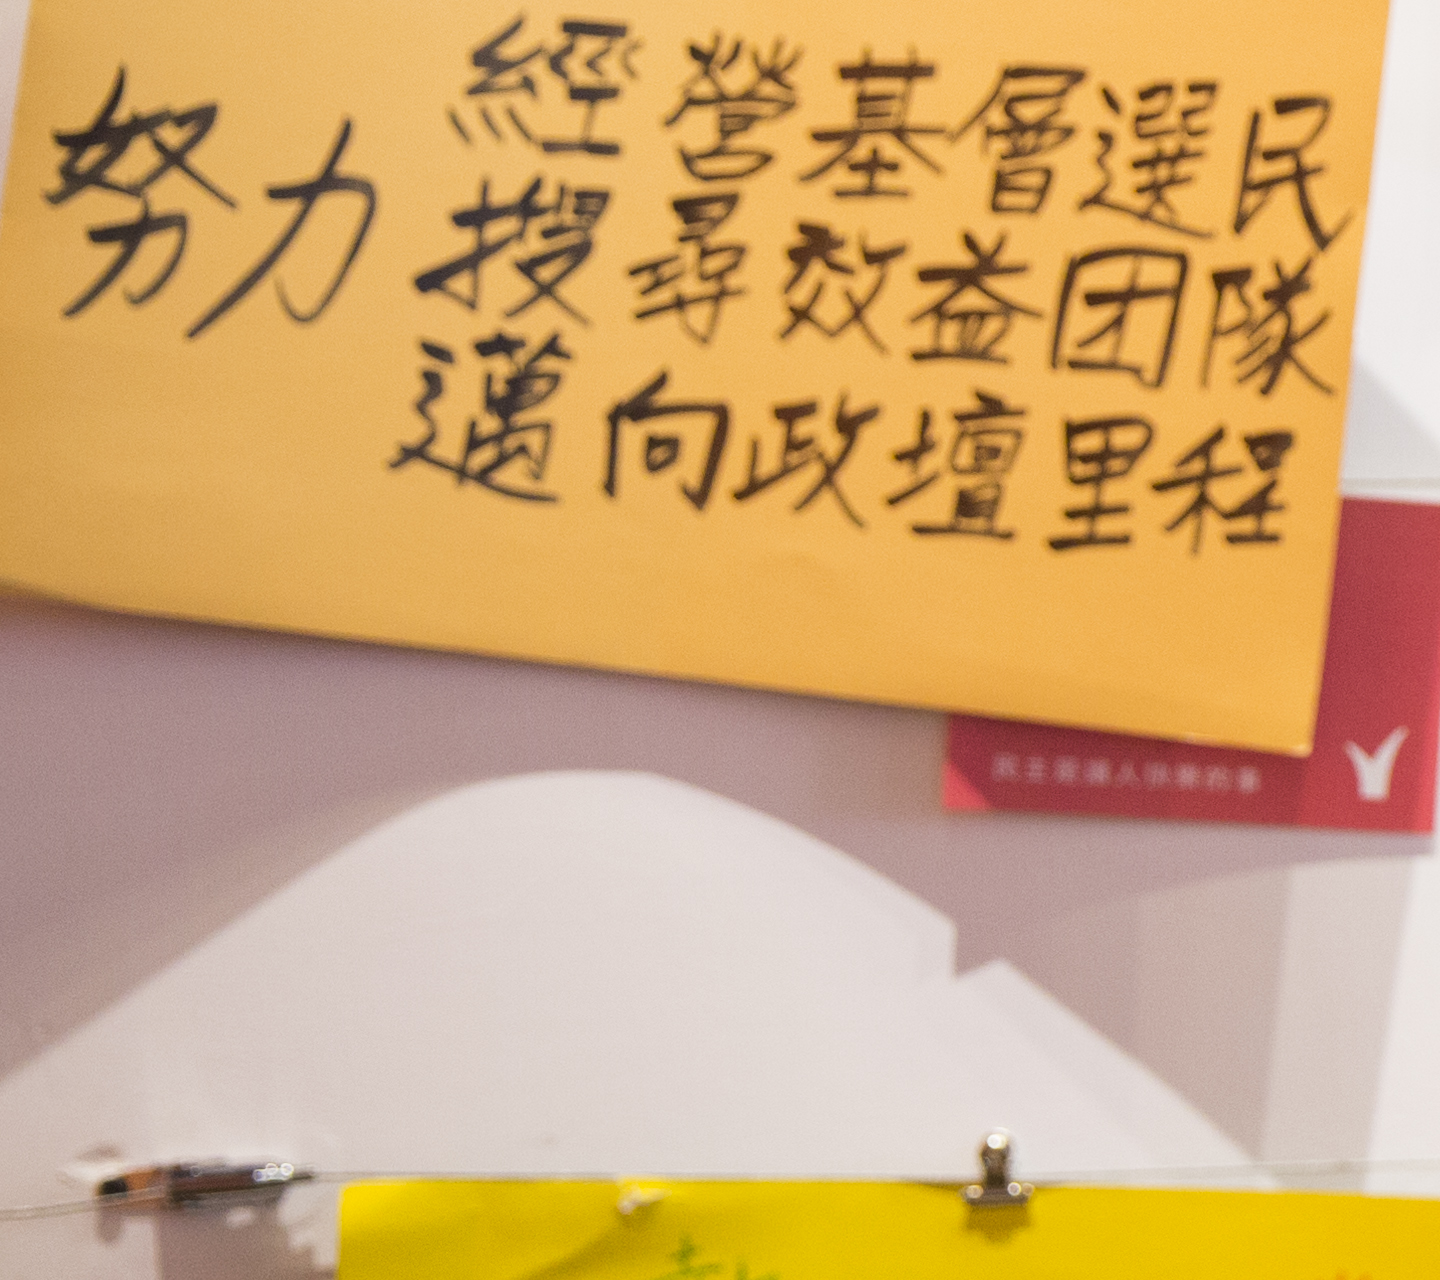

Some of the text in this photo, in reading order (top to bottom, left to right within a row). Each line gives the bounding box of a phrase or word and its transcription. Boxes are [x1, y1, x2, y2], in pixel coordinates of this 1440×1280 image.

[42, 62, 380, 342] 努力
[445, 15, 1354, 252] 經營基層選民
[387, 330, 1297, 556] 邁向政壇里程
